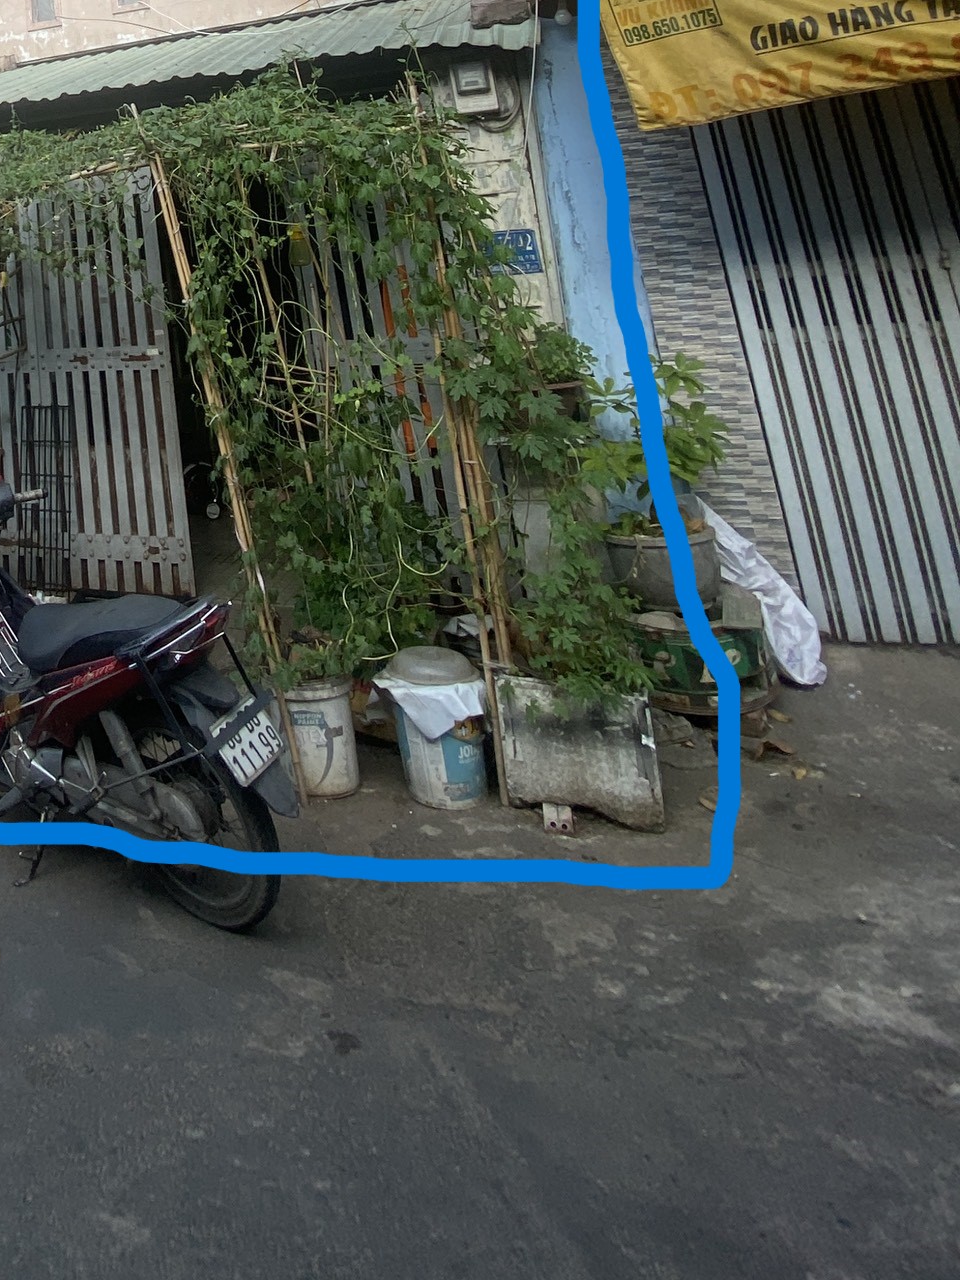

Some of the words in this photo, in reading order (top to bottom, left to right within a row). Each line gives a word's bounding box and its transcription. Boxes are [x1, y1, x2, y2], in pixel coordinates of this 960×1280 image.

[623, 7, 718, 44] 098.650.1075
[750, 15, 820, 52] GIAO
[827, 0, 916, 37] HÀNG
